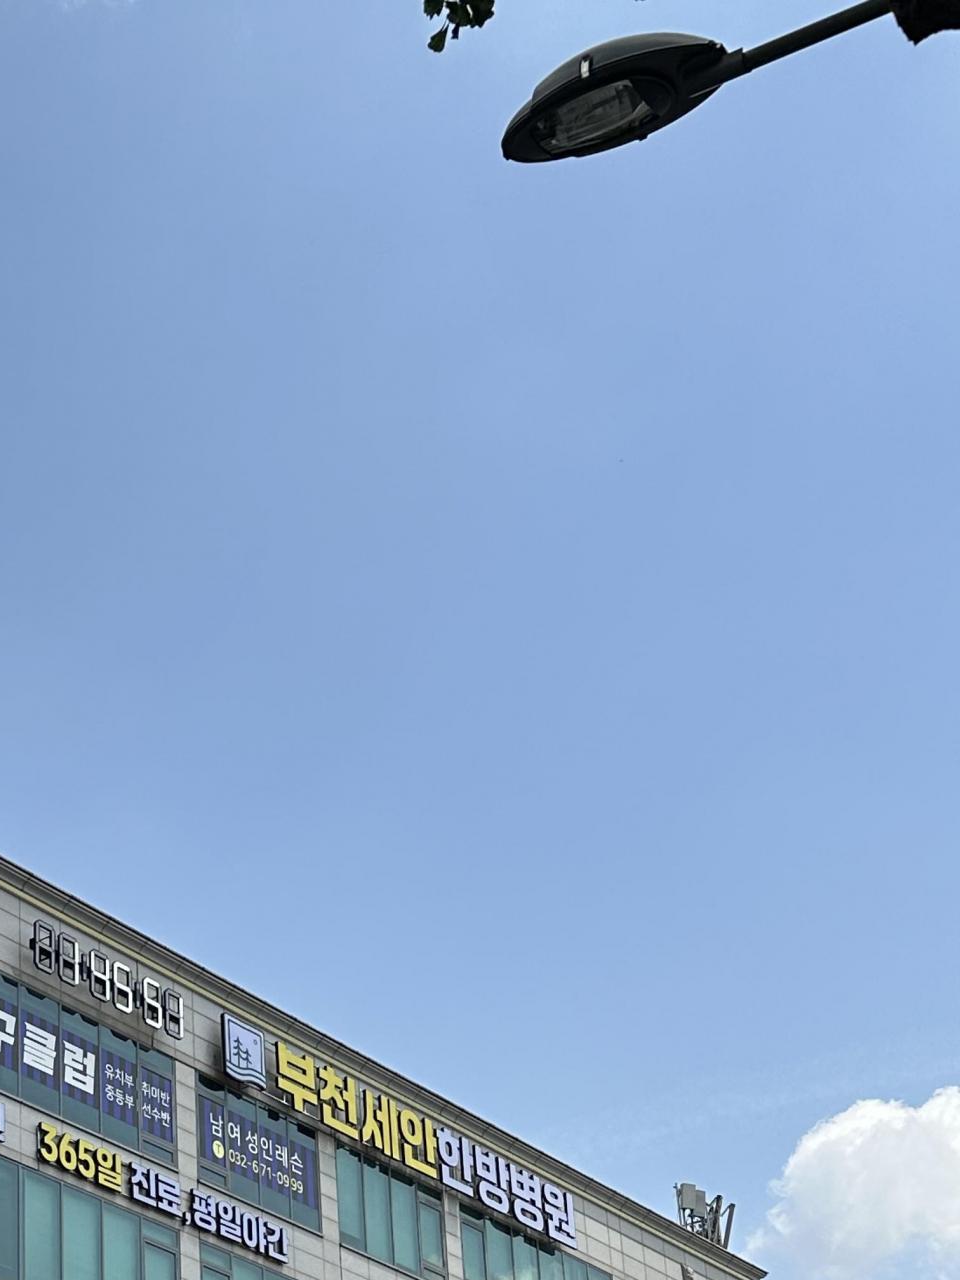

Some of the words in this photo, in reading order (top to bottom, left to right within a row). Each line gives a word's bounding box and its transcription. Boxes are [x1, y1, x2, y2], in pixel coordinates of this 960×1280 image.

[103, 1063, 135, 1089] 유치부
[141, 1080, 170, 1107] 취미반
[104, 1084, 135, 1109] 중등부
[141, 1103, 171, 1128] 선수반
[37, 1122, 123, 1195] 365일
[228, 1148, 304, 1194] 032-671-0999
